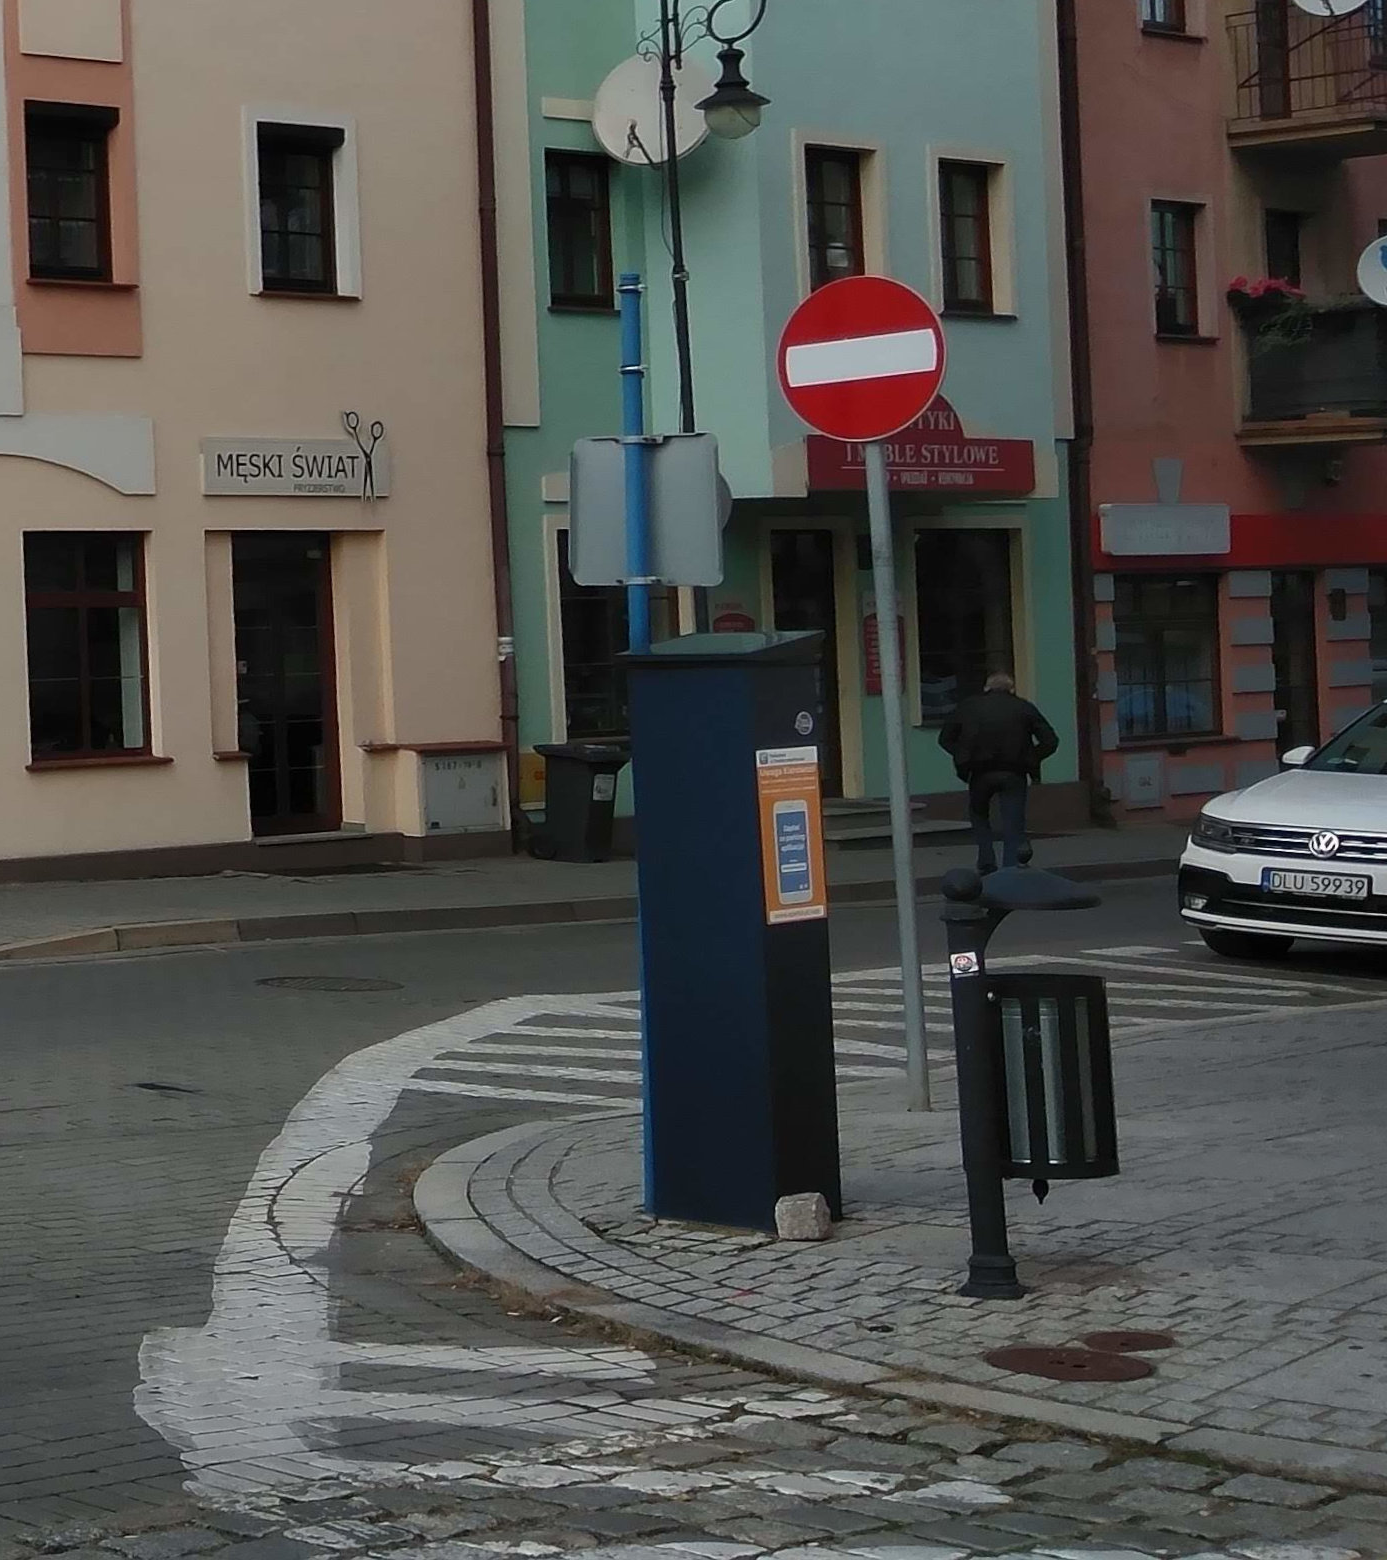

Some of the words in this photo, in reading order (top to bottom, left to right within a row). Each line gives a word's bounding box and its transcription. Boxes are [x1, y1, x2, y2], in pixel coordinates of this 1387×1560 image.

[910, 411, 955, 431] TYKI
[216, 453, 284, 483] MĘSKI
[292, 446, 359, 479] ŚWIAT
[921, 444, 999, 465] STYLOWE
[1272, 872, 1305, 890] DLU
[1310, 876, 1365, 895] 59939
